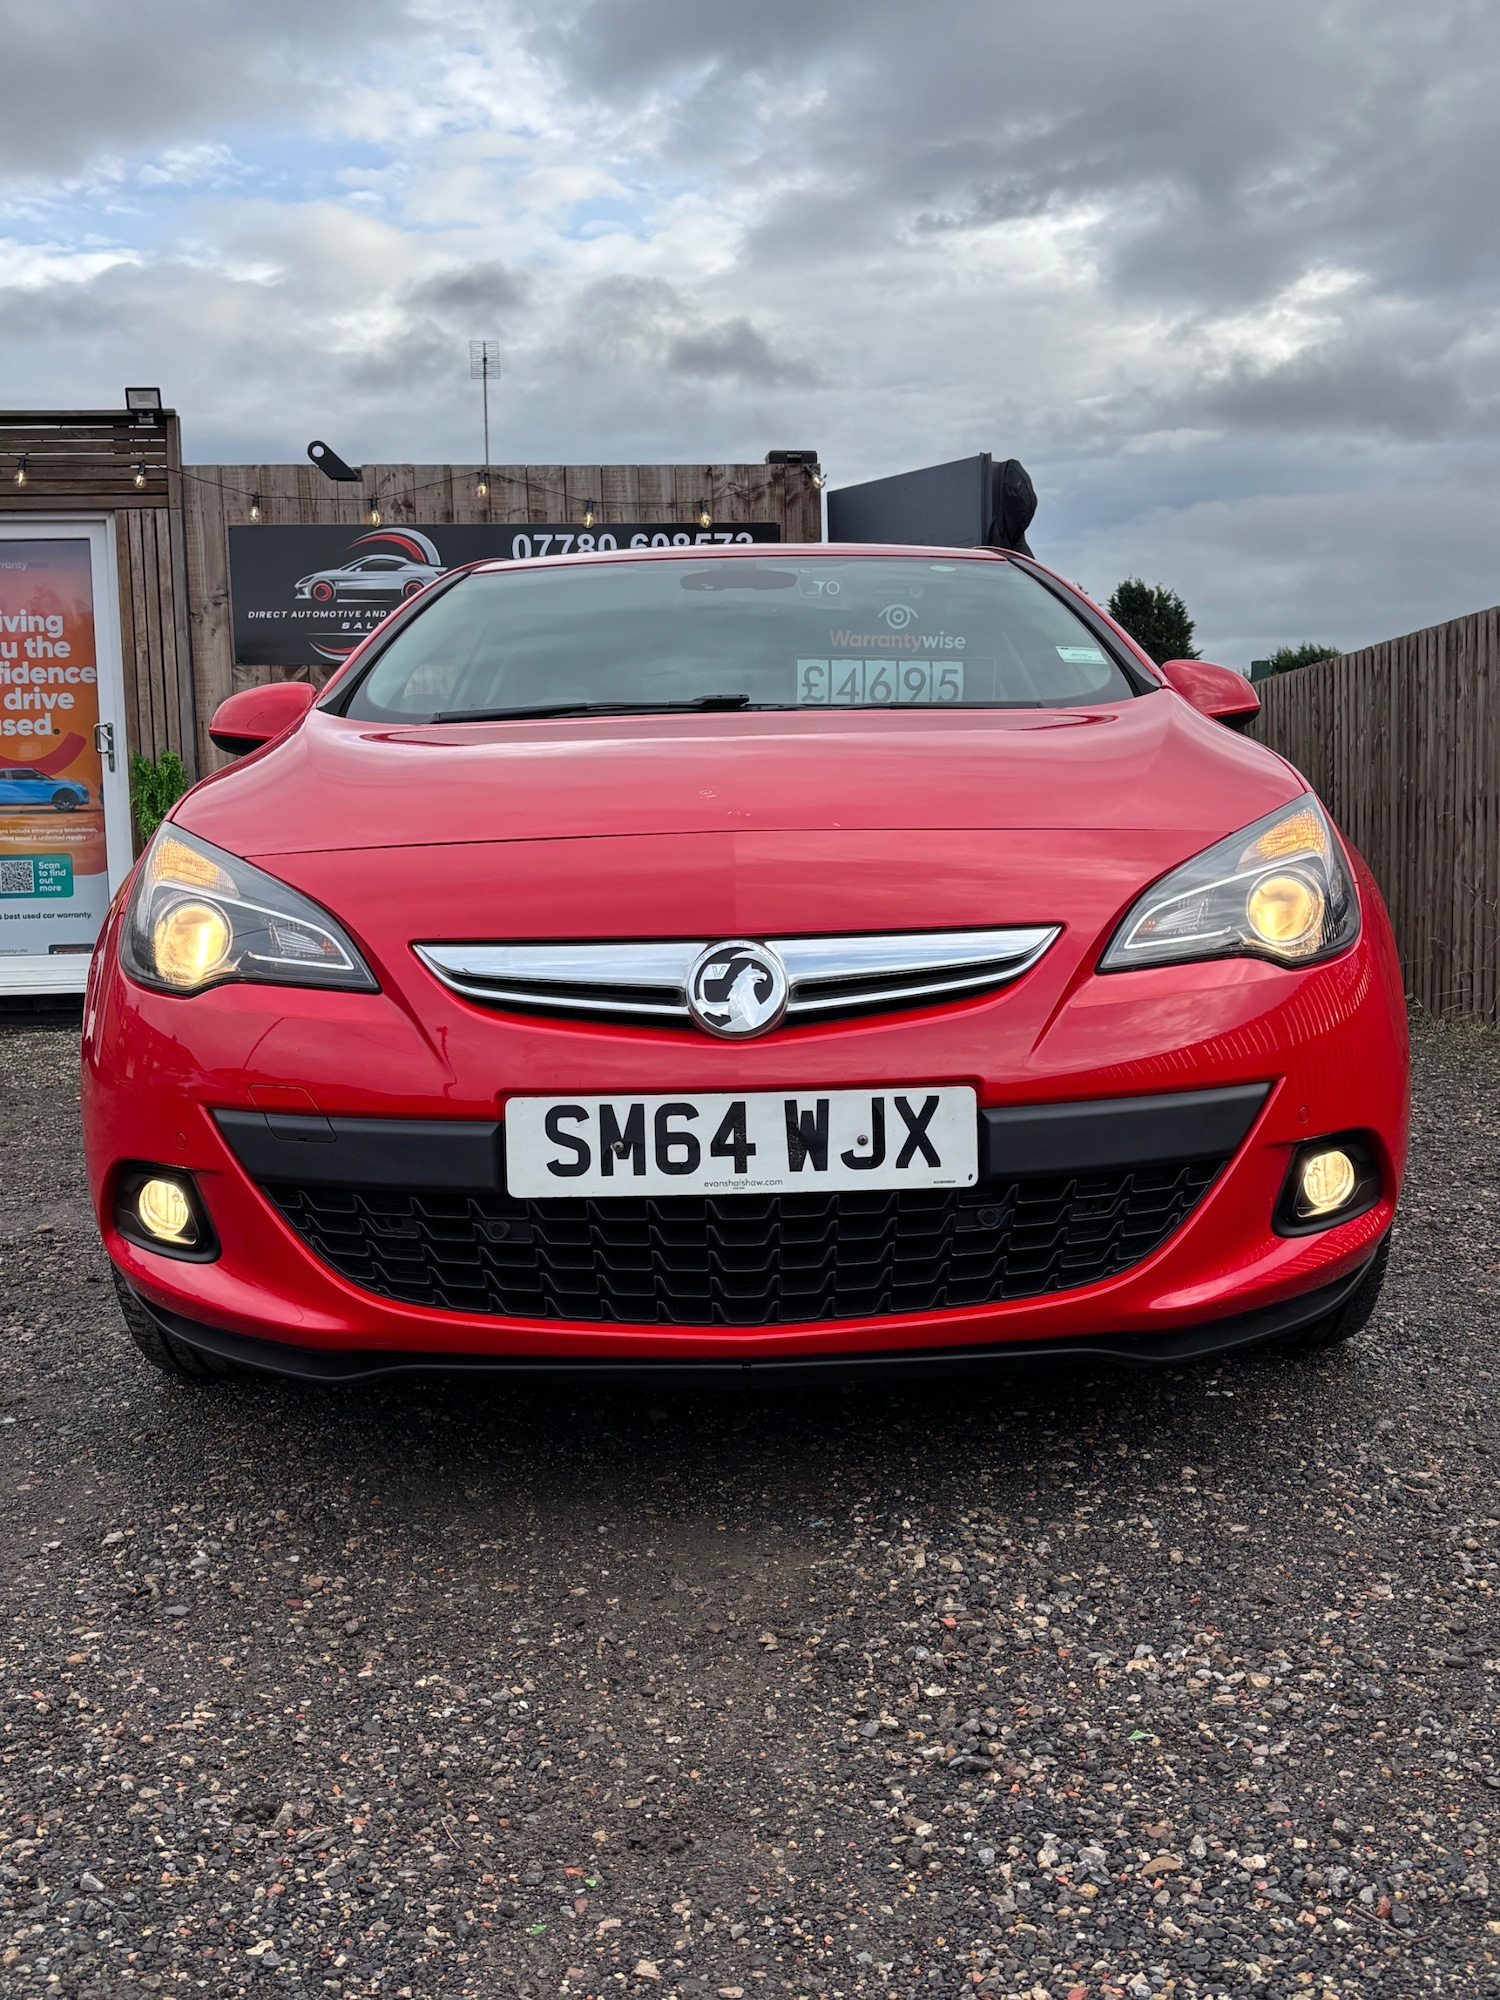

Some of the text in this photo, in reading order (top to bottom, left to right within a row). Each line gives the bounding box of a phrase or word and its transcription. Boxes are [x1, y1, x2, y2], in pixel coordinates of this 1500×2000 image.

[512, 533, 618, 560] 07780
[248, 611, 287, 619] DIRECT
[291, 610, 362, 618] AUTOMOTIVE
[365, 610, 387, 618] AND
[24, 635, 71, 658] the
[829, 629, 966, 652] Warrantywise
[800, 665, 960, 702] £4695
[3, 686, 75, 710] drive
[0, 712, 60, 736] sed.
[32, 827, 63, 835] emergency
[38, 861, 60, 870] Scan
[50, 869, 66, 877] find
[4, 912, 21, 920] best
[57, 912, 92, 920] warranty.
[544, 1095, 942, 1177] SM64 WJX
[704, 1179, 783, 1188] evanshalshaw.com
